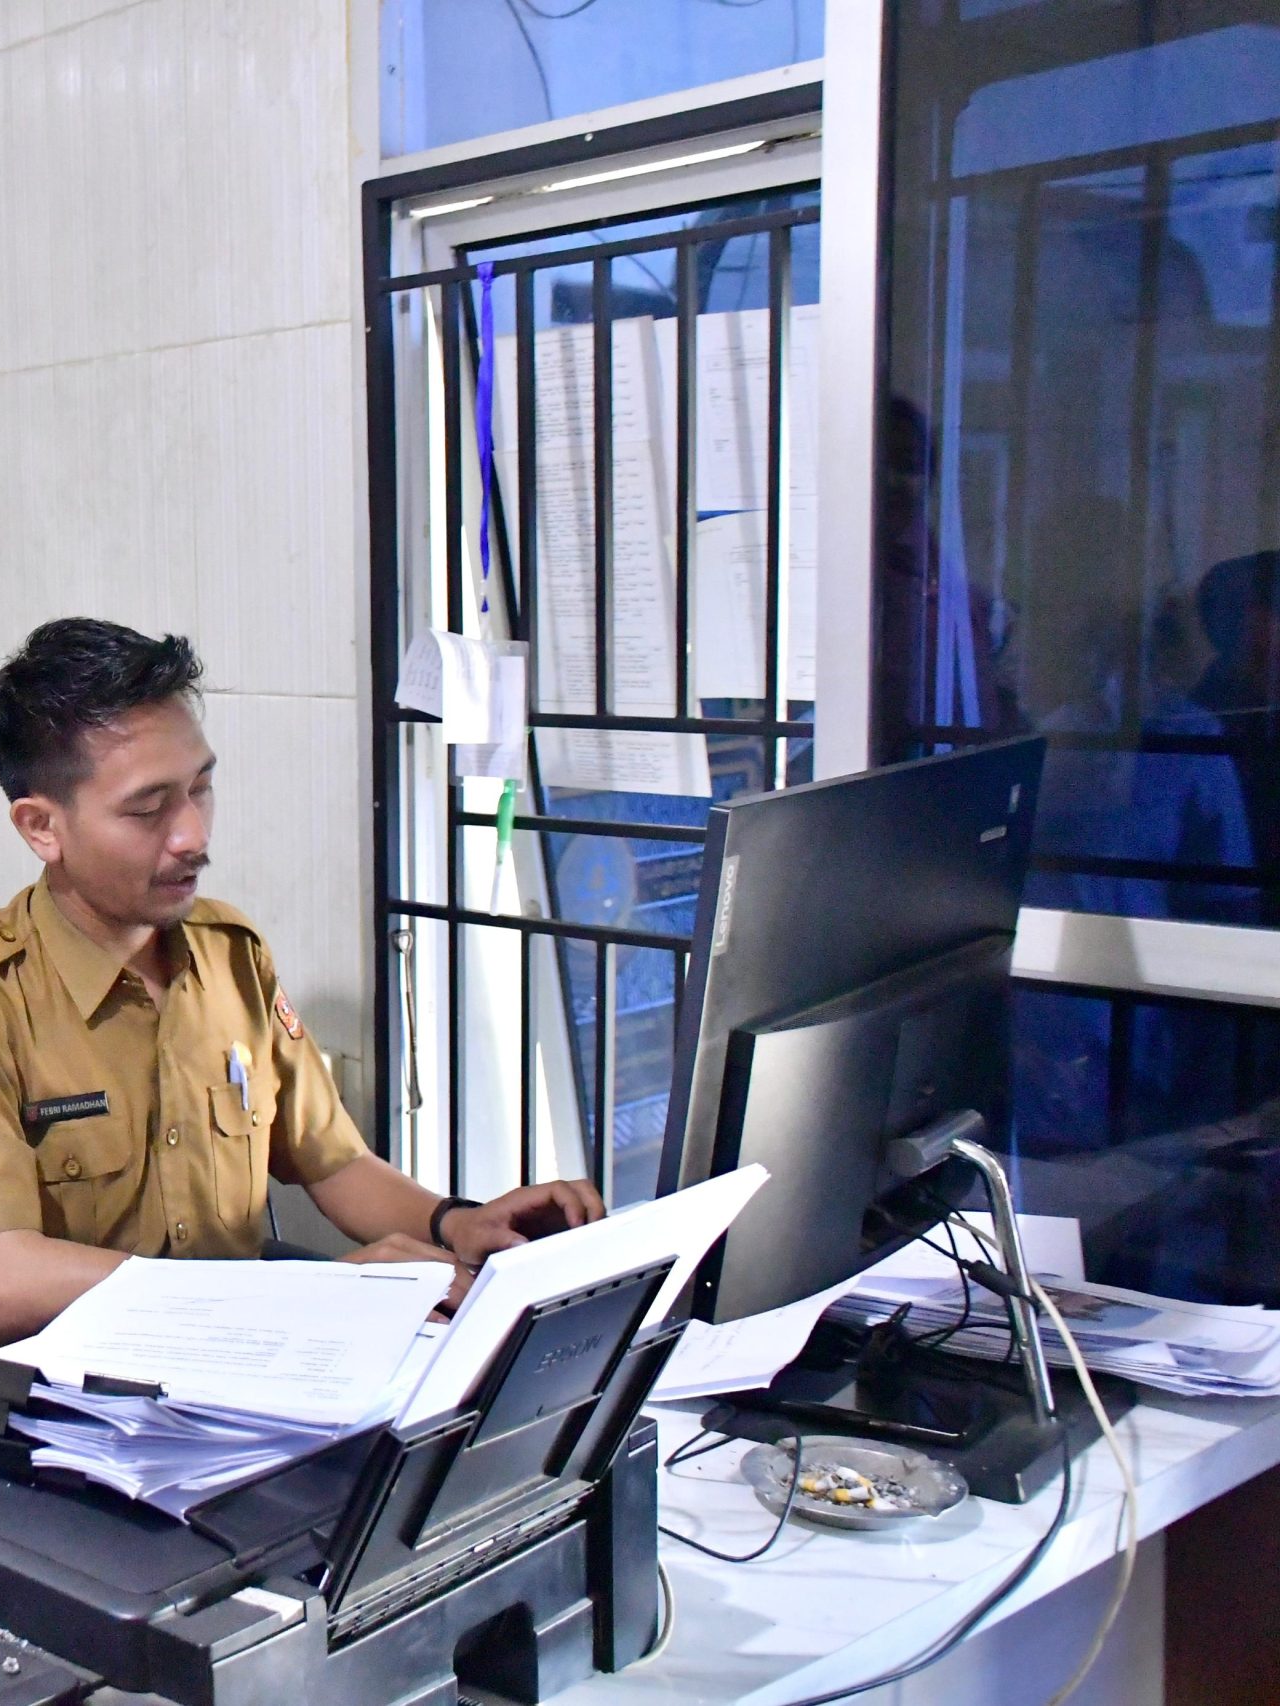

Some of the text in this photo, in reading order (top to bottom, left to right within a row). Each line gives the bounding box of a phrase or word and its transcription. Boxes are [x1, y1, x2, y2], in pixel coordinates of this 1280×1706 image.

[714, 864, 735, 948] Lenovo
[40, 1098, 107, 1117] FEBRI RAMADHAN
